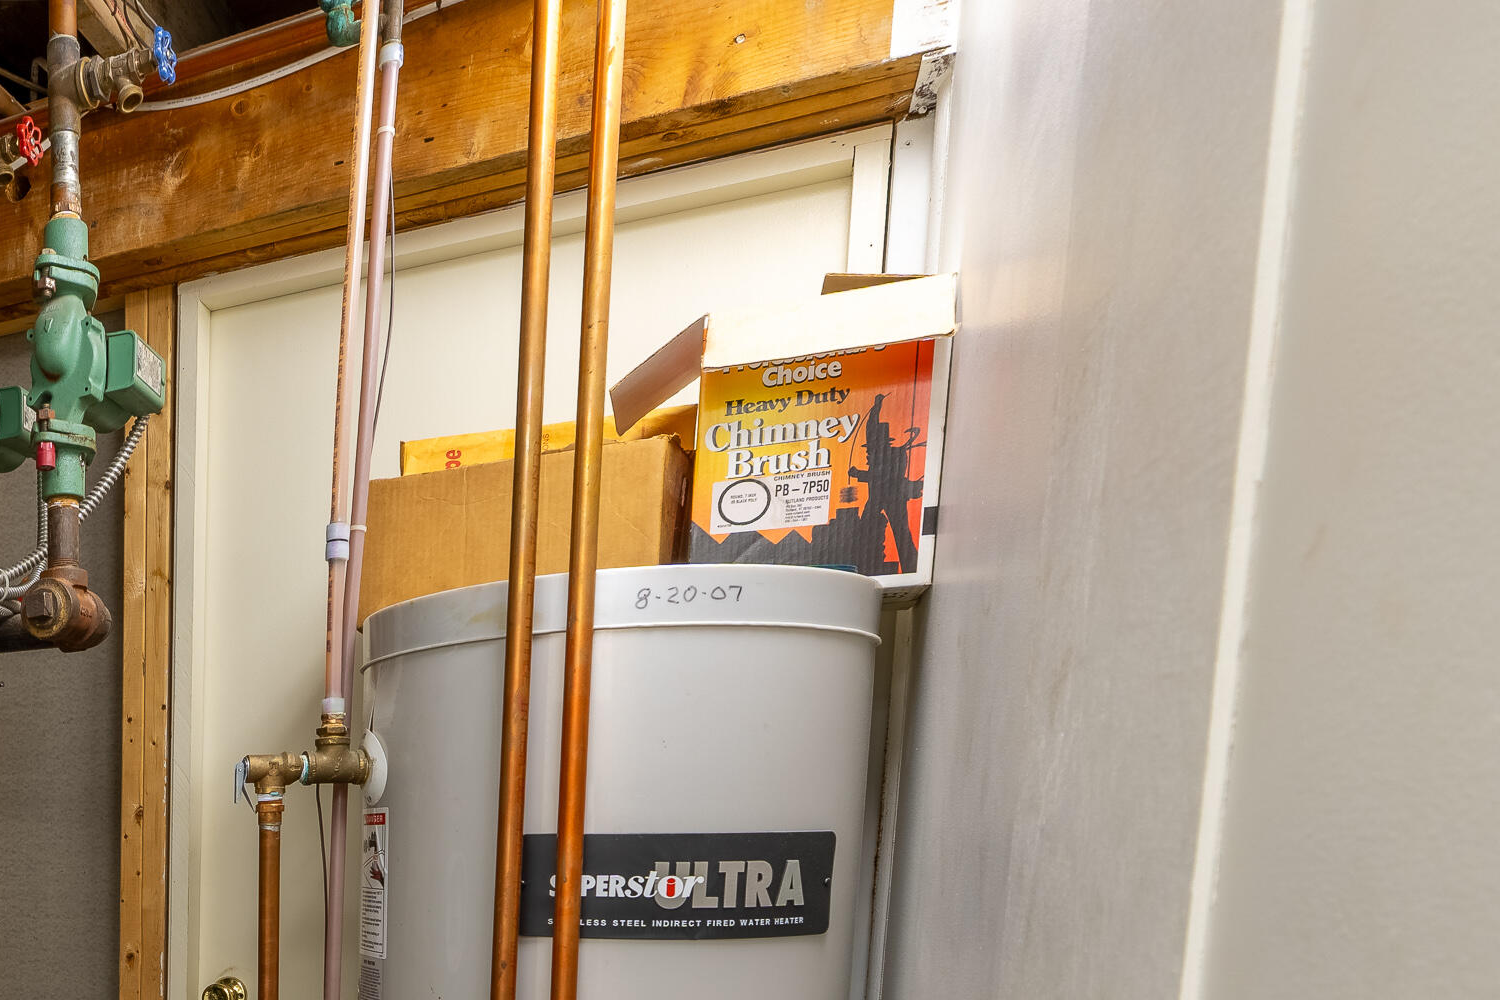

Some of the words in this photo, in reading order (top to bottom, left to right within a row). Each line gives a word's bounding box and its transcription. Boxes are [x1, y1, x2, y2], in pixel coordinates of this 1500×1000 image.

[762, 360, 842, 387] Choice
[724, 396, 791, 416] Heavy
[795, 386, 850, 407] Duty
[704, 413, 860, 452] Chimney
[725, 440, 832, 479] Brush
[773, 473, 805, 481] CHIMNEY
[807, 470, 830, 478] BRUSH
[635, 585, 742, 609] 8-20-07
[654, 859, 805, 910] ULTRA
[547, 918, 607, 928] SLESS
[612, 919, 646, 928] STEEL
[651, 919, 702, 928] INDIRECT
[706, 918, 735, 927] FIRED
[740, 918, 771, 927] WATER
[774, 916, 804, 925] HEATER
